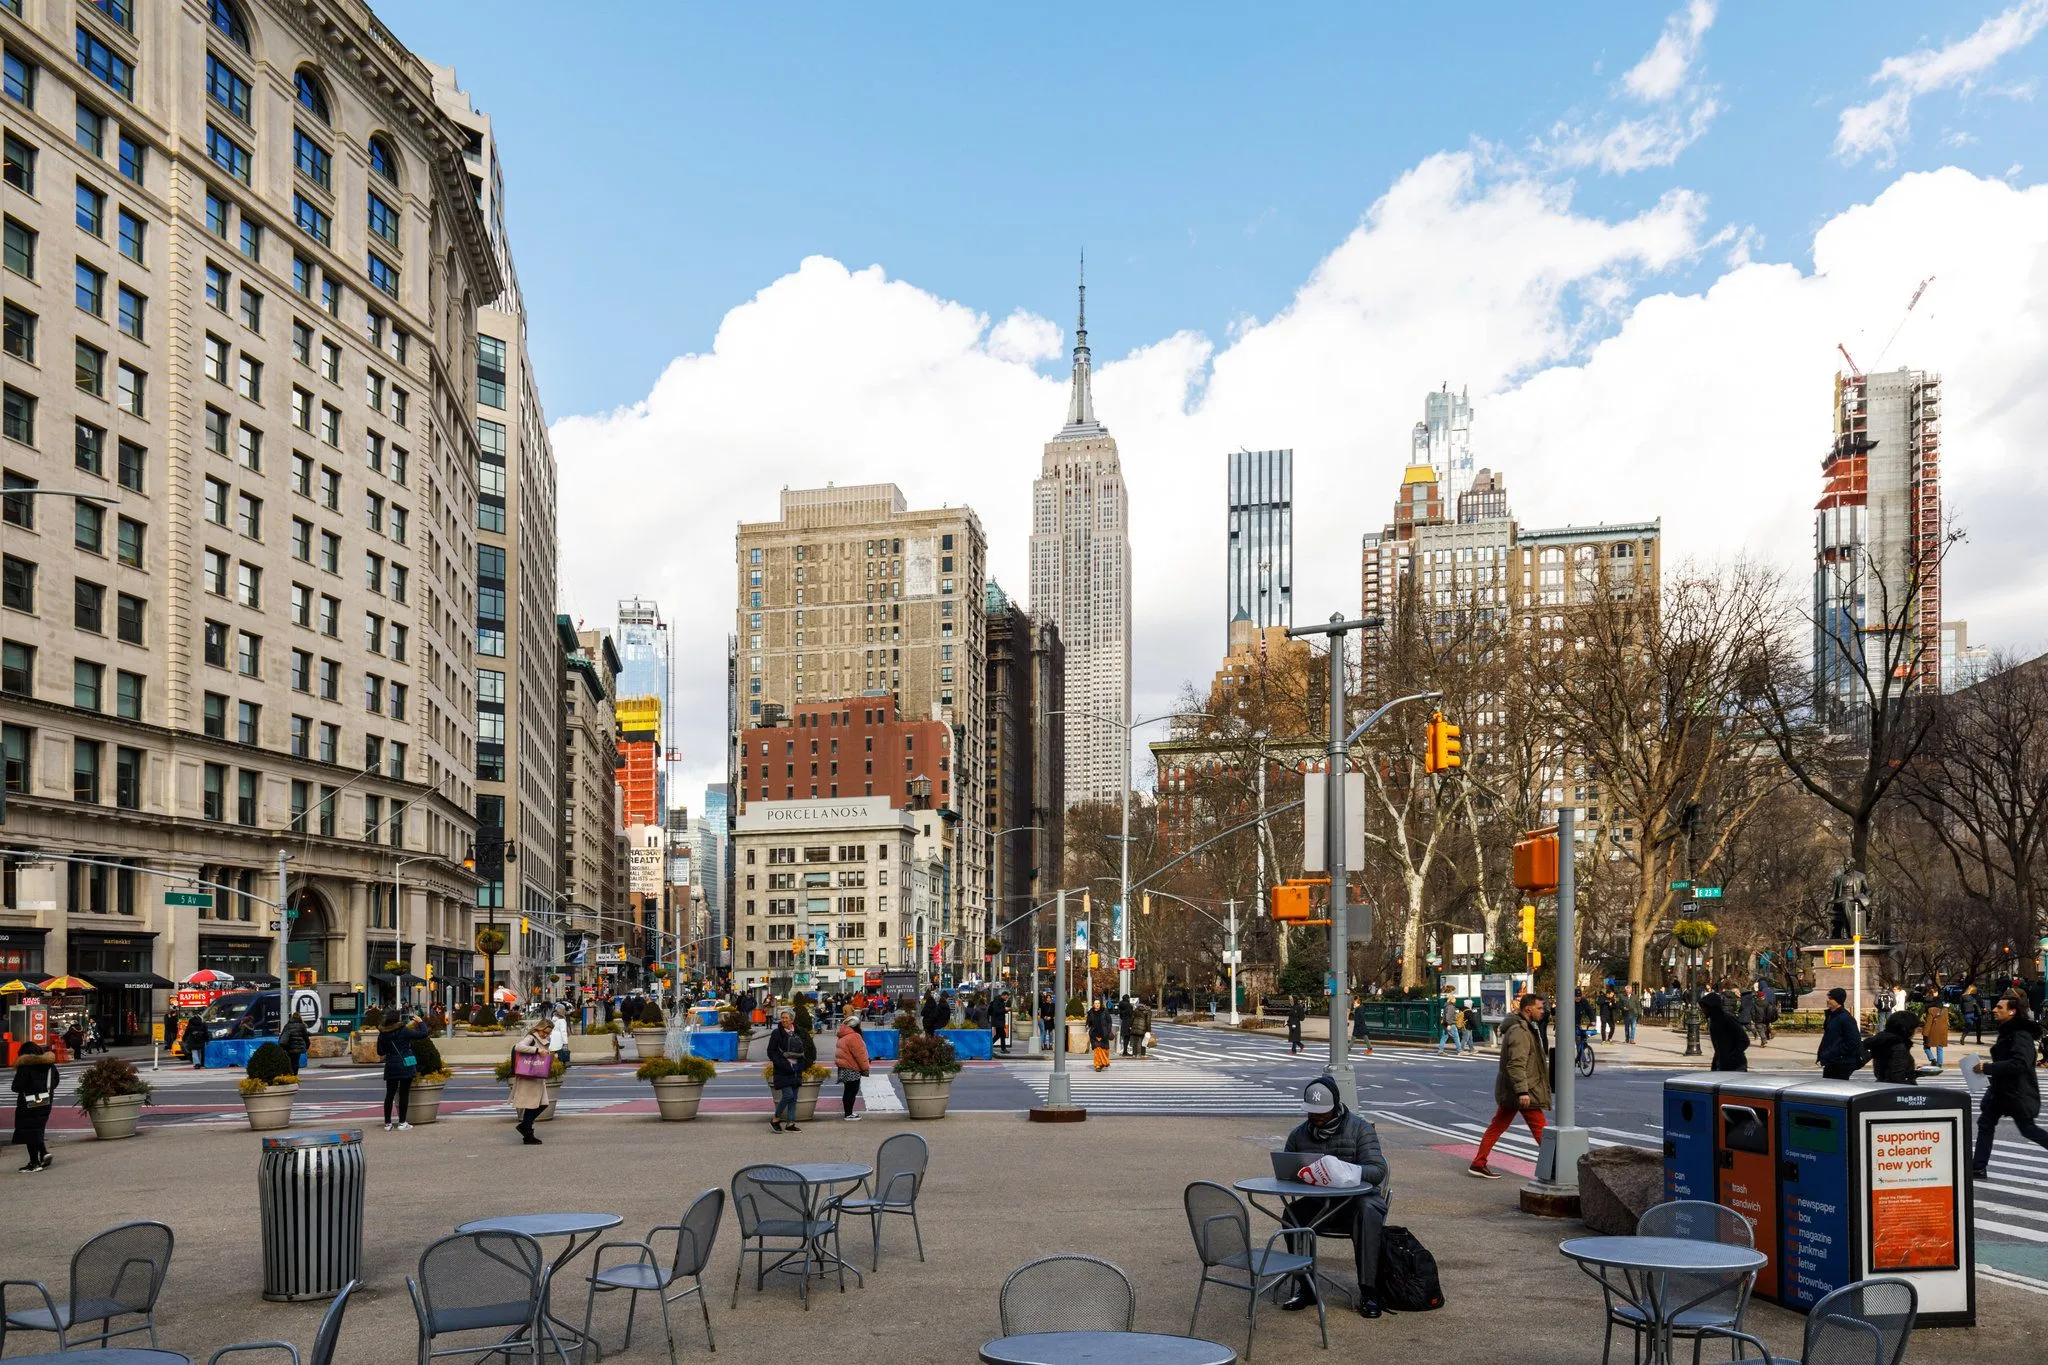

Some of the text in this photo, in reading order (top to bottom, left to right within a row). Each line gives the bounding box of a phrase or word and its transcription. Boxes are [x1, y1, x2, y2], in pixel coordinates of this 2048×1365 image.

[767, 807, 868, 820] PORCELANOSA
[187, 896, 197, 904] Av
[1312, 1091, 1321, 1101] NY
[1896, 1095, 1927, 1103] BigBelly
[1877, 1130, 1940, 1144] supporting
[1877, 1145, 1932, 1157] a cleaner
[1877, 1157, 1933, 1173] new york
[1674, 1172, 1686, 1180] can
[1674, 1183, 1691, 1195] bottle
[1732, 1183, 1748, 1195] trash
[1732, 1199, 1761, 1212] sandwich
[1797, 1199, 1836, 1215] newspaper
[1798, 1211, 1812, 1223] box
[1798, 1229, 1832, 1244] magazine
[1797, 1242, 1828, 1259] junkmail
[1798, 1257, 1817, 1271] letter
[1797, 1287, 1814, 1302] lotto
